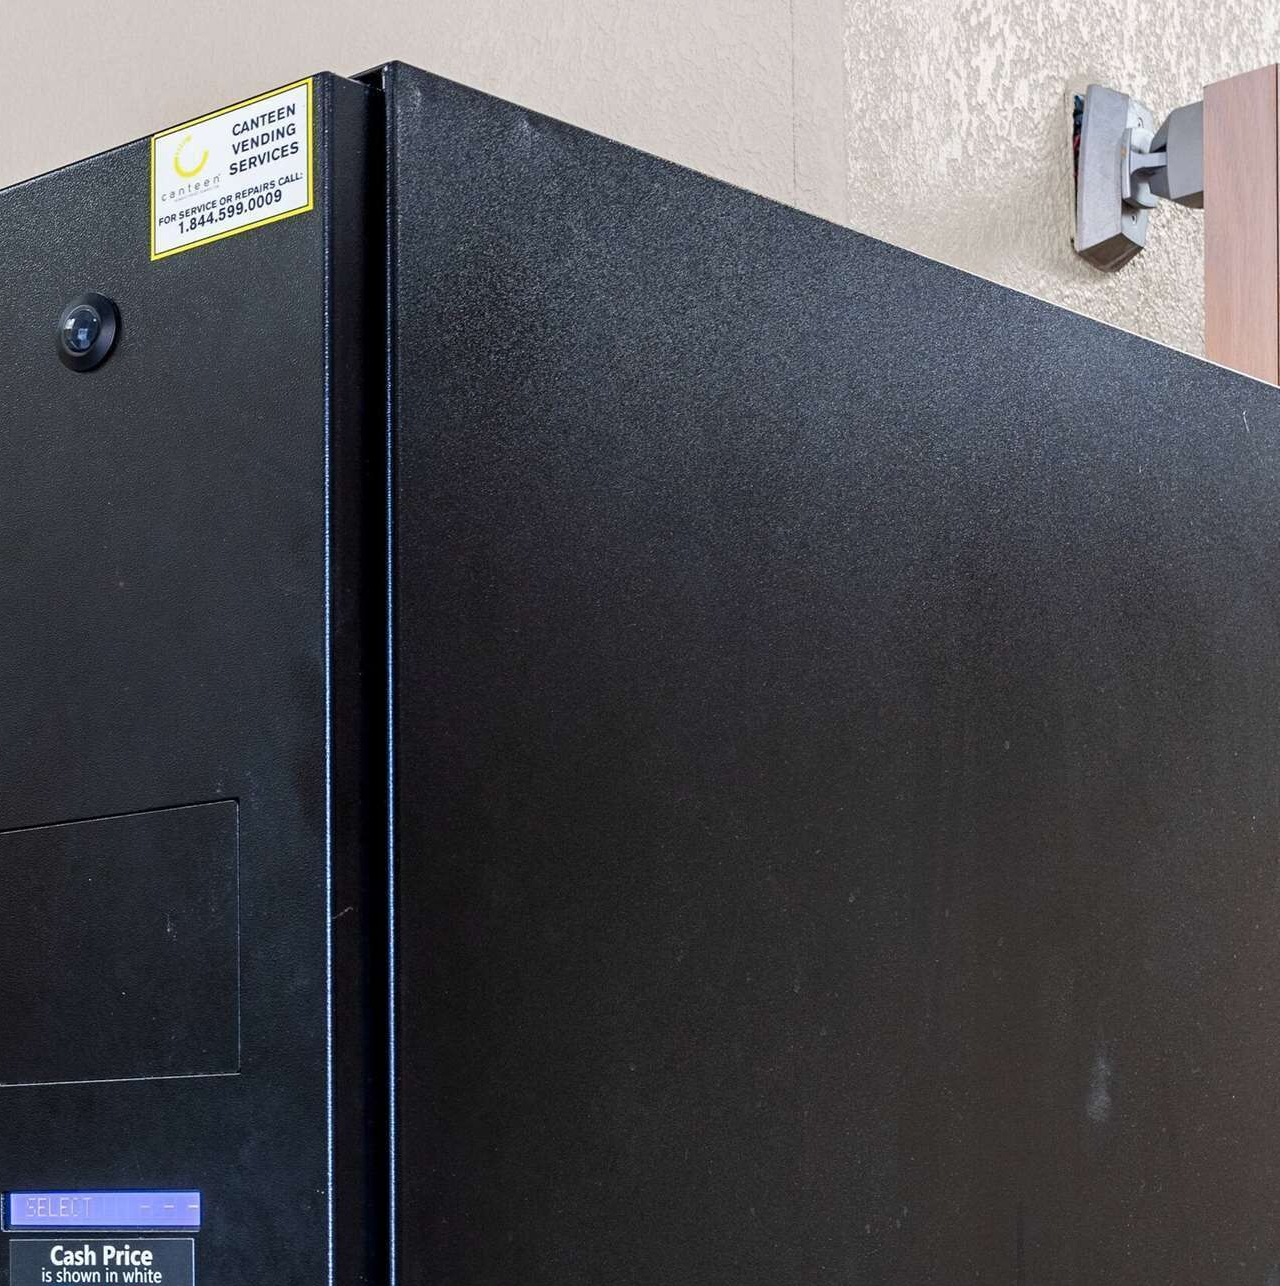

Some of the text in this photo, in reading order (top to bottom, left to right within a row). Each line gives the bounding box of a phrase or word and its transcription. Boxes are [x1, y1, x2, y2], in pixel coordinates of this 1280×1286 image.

[232, 104, 297, 137] CANTEEN
[232, 124, 297, 155] VENDING
[229, 142, 299, 176] SERVICES
[159, 215, 176, 227] FOR
[179, 202, 218, 220] SERVICE
[219, 195, 233, 207] OR
[235, 180, 275, 202] REPAIRS
[161, 175, 220, 202] canteen
[178, 190, 282, 234] 1.844.599.0009
[26, 1198, 93, 1217] SELECT
[50, 1244, 153, 1266] Cash Price
[42, 1267, 162, 1284] is shown in white
